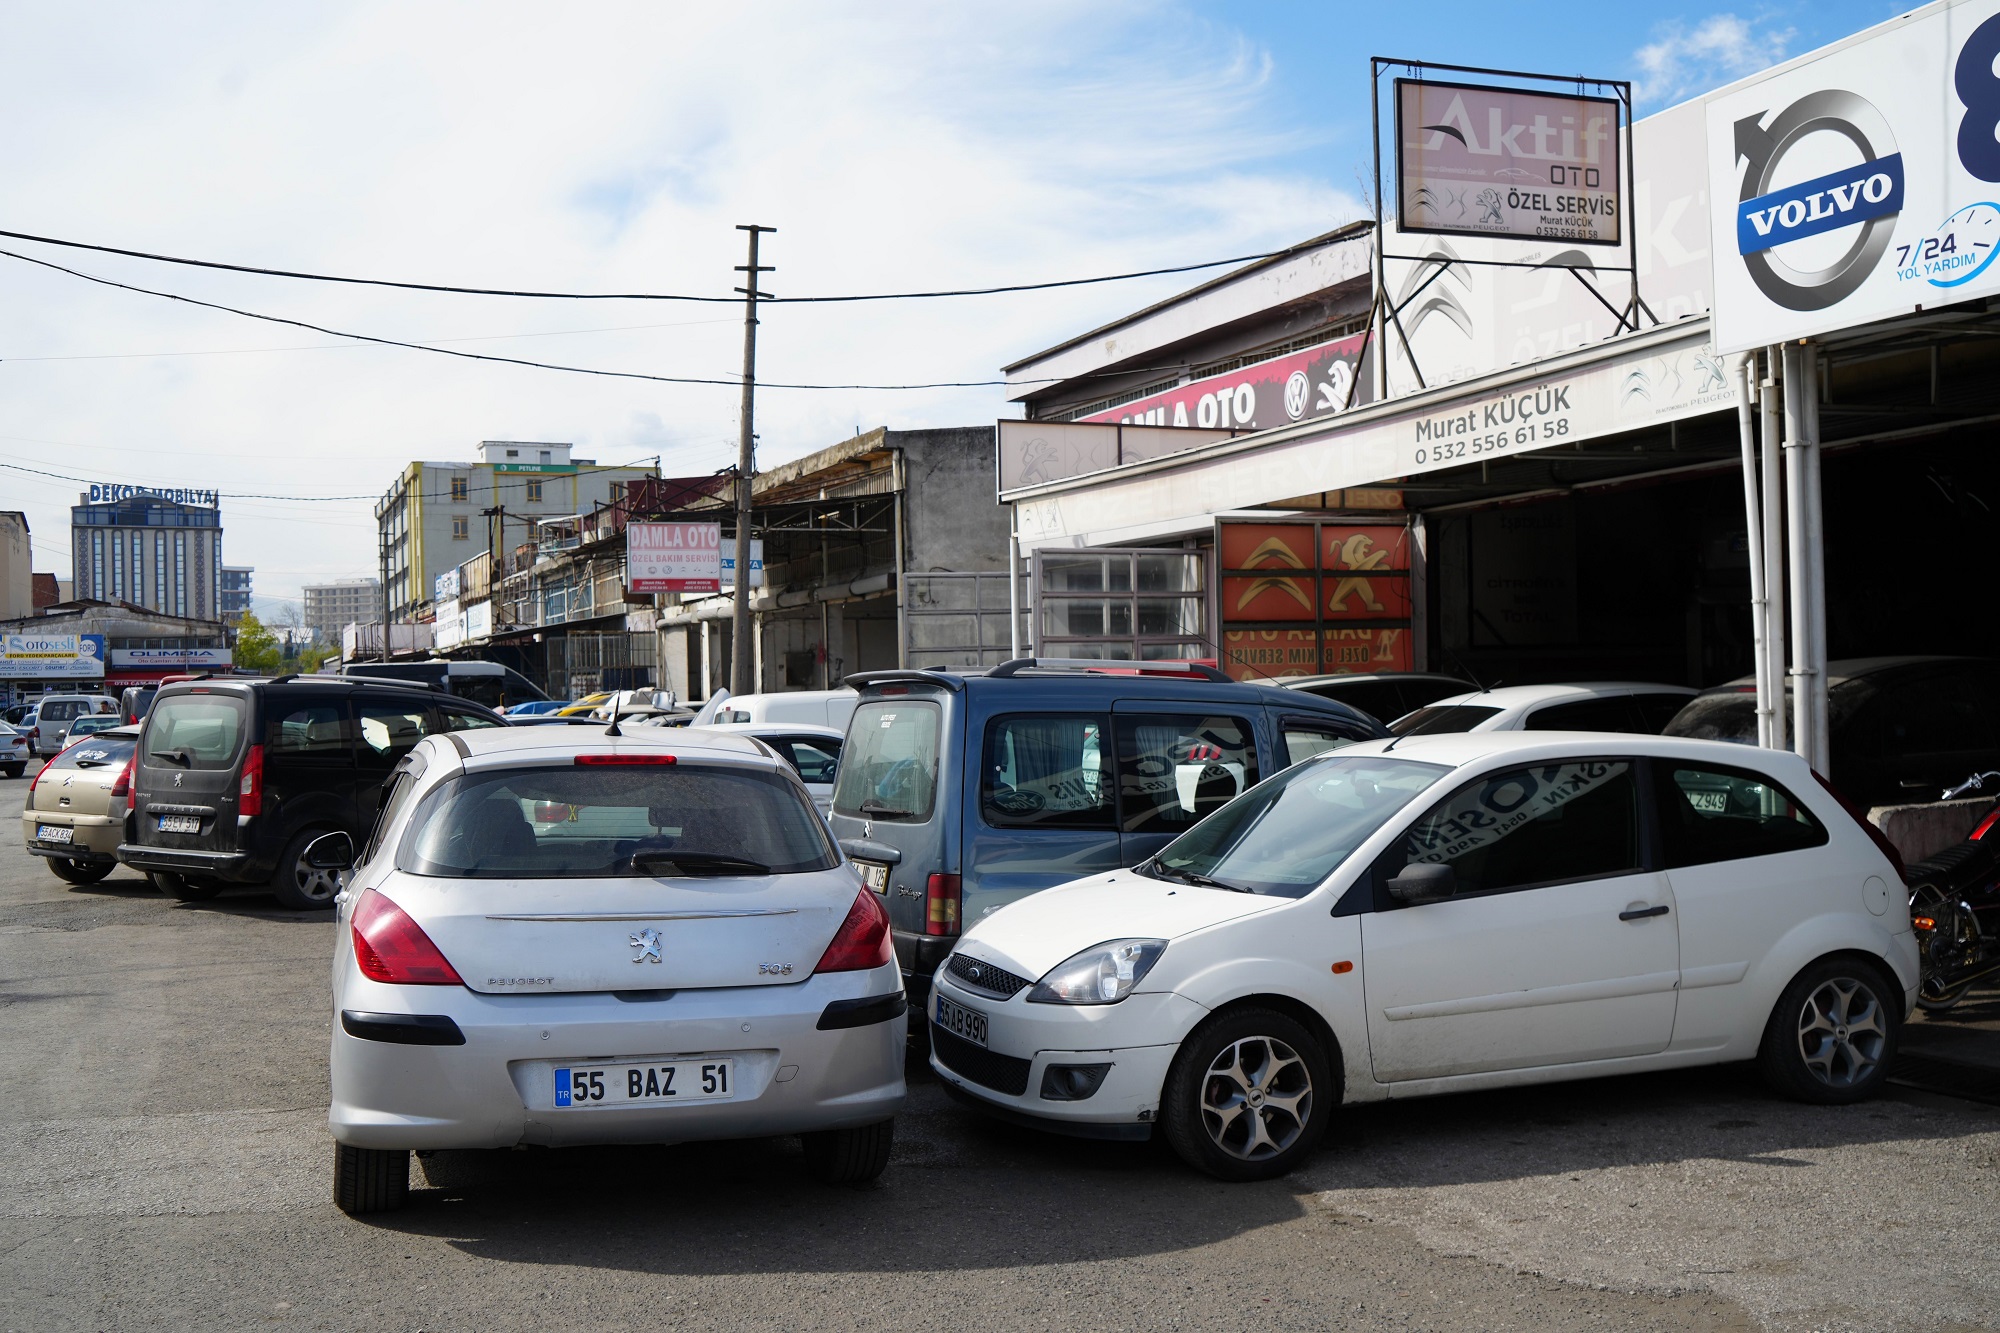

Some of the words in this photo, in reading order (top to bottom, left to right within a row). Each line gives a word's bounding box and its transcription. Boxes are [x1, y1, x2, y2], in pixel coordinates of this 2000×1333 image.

[1406, 92, 1608, 165] Aktif
[1550, 165, 1600, 188] OTO
[1508, 187, 1551, 211] ÖZEL
[1557, 195, 1615, 216] SERVİS
[1746, 173, 1893, 236] VOLVO
[1536, 227, 1541, 235] 0
[1544, 228, 1558, 236] 532
[1561, 229, 1575, 238] 556
[1578, 230, 1586, 238] 61
[1588, 230, 1598, 239] 58
[1540, 216, 1563, 225] Murat
[1565, 216, 1594, 227] KÜÇÜK
[1897, 233, 1957, 267] 7/24
[1897, 266, 1920, 282] YOL
[1924, 253, 1976, 275] YARDIM
[1197, 382, 1256, 428] OTO
[1691, 390, 1737, 406] PEUGEOT
[1415, 409, 1476, 442] Murat
[1484, 385, 1571, 428] KÜÇÜK
[1415, 449, 1427, 465] 0
[1432, 440, 1466, 463] 532
[1472, 431, 1508, 454] 556
[1515, 424, 1536, 445] 61
[1543, 418, 1569, 439] 58
[631, 526, 683, 548] DAMLA
[688, 526, 718, 548] OTO
[632, 553, 653, 563] ÖZEL
[656, 554, 683, 563] BAKIM
[686, 553, 718, 563] SERVİSİ
[487, 977, 554, 986] PEUGEOT
[758, 962, 793, 975] 308
[558, 1090, 569, 1099] TR
[573, 1071, 605, 1101] 55
[628, 1067, 676, 1099] BAZ
[702, 1065, 727, 1093] 51
